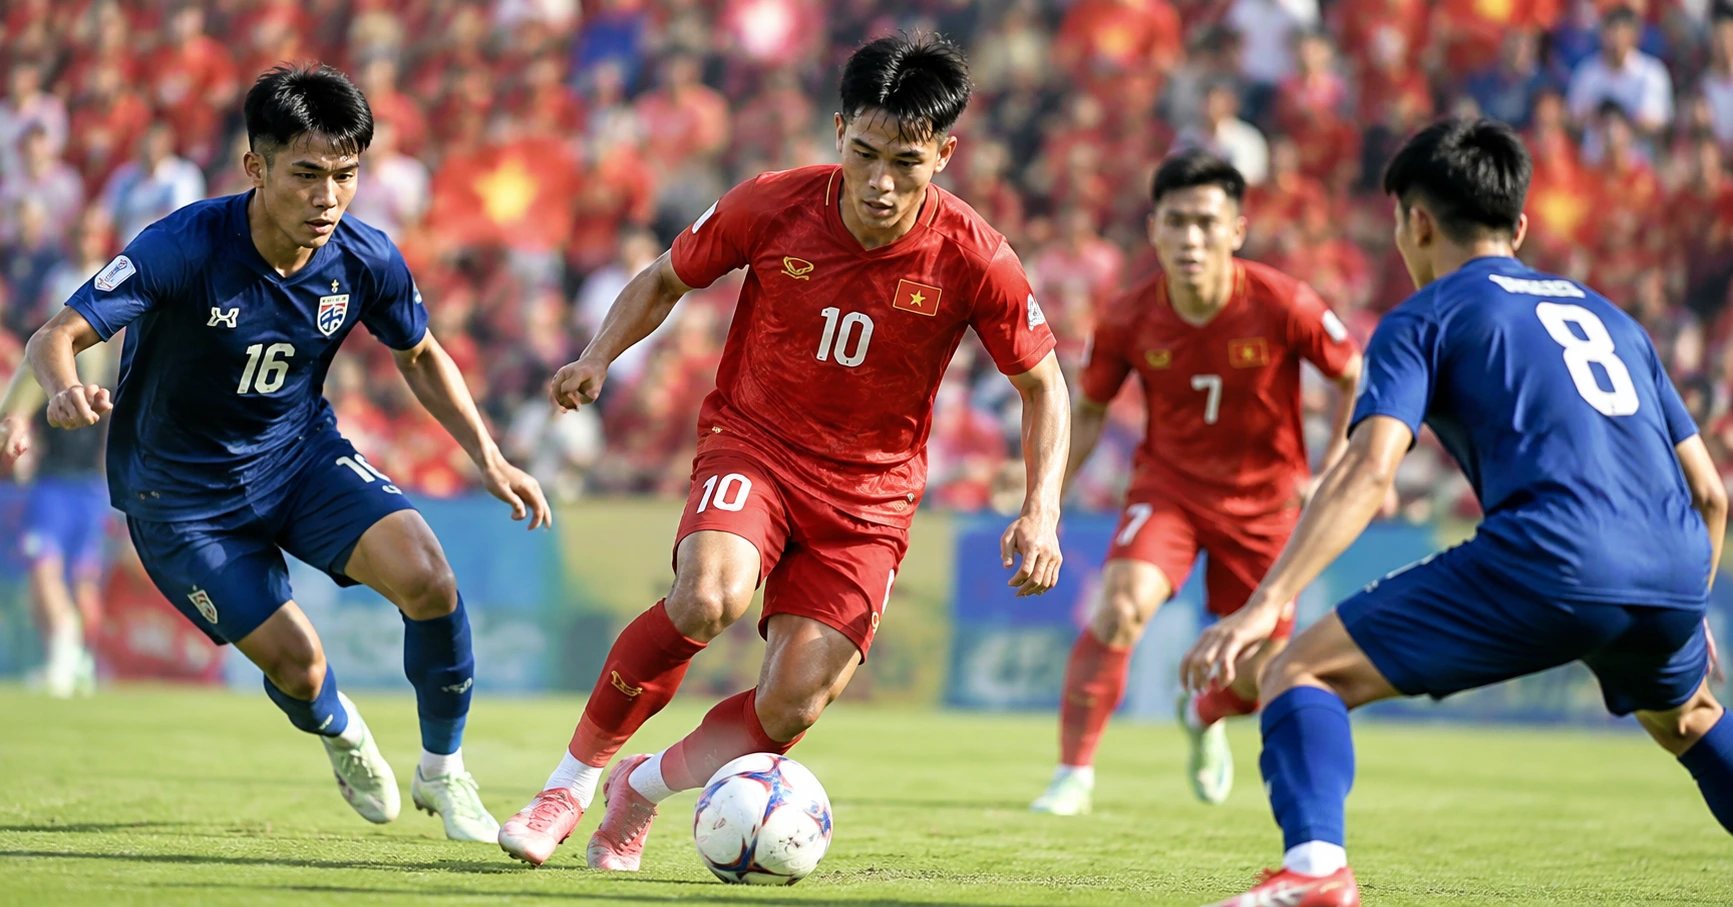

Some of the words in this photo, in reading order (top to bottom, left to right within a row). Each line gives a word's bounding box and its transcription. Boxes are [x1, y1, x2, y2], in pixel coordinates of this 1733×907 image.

[816, 306, 875, 368] 10
[1535, 301, 1640, 417] 8
[236, 342, 296, 394] 16
[1190, 374, 1223, 425] 7
[696, 473, 753, 514] 10
[1116, 502, 1154, 547] 7
